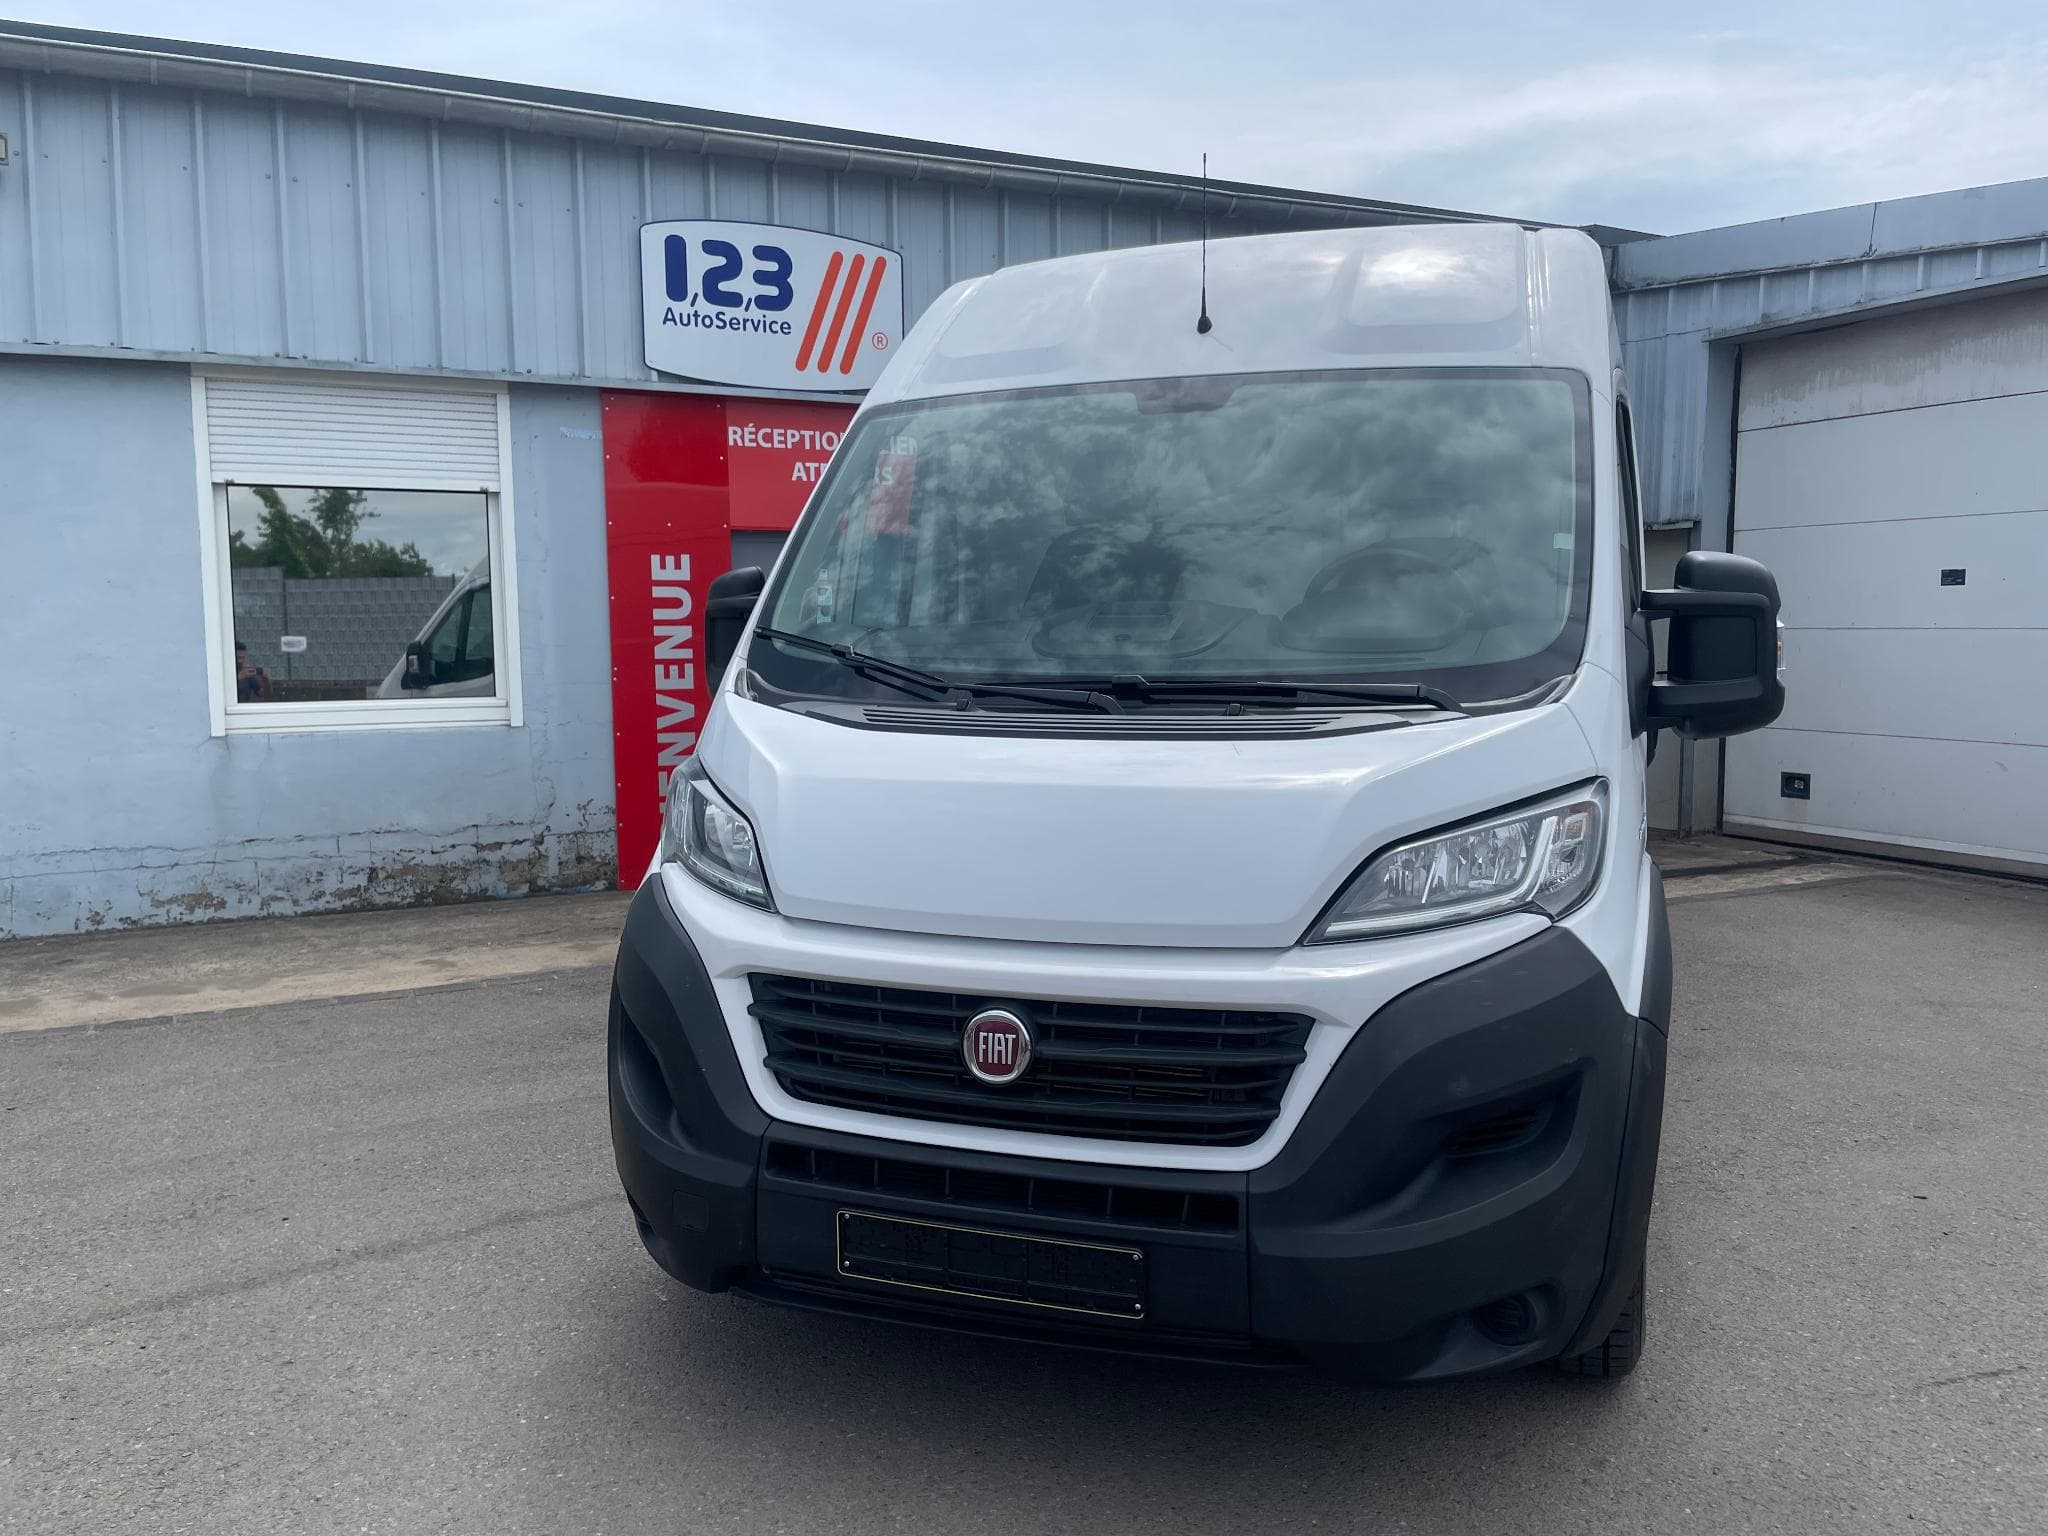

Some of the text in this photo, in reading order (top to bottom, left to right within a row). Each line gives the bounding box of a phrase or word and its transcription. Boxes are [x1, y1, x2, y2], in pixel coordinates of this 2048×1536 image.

[662, 306, 792, 336] AutoService
[728, 424, 848, 451] RÉCEPTIO
[650, 553, 696, 814] NVENUE
[978, 1031, 1017, 1065] FIAT
